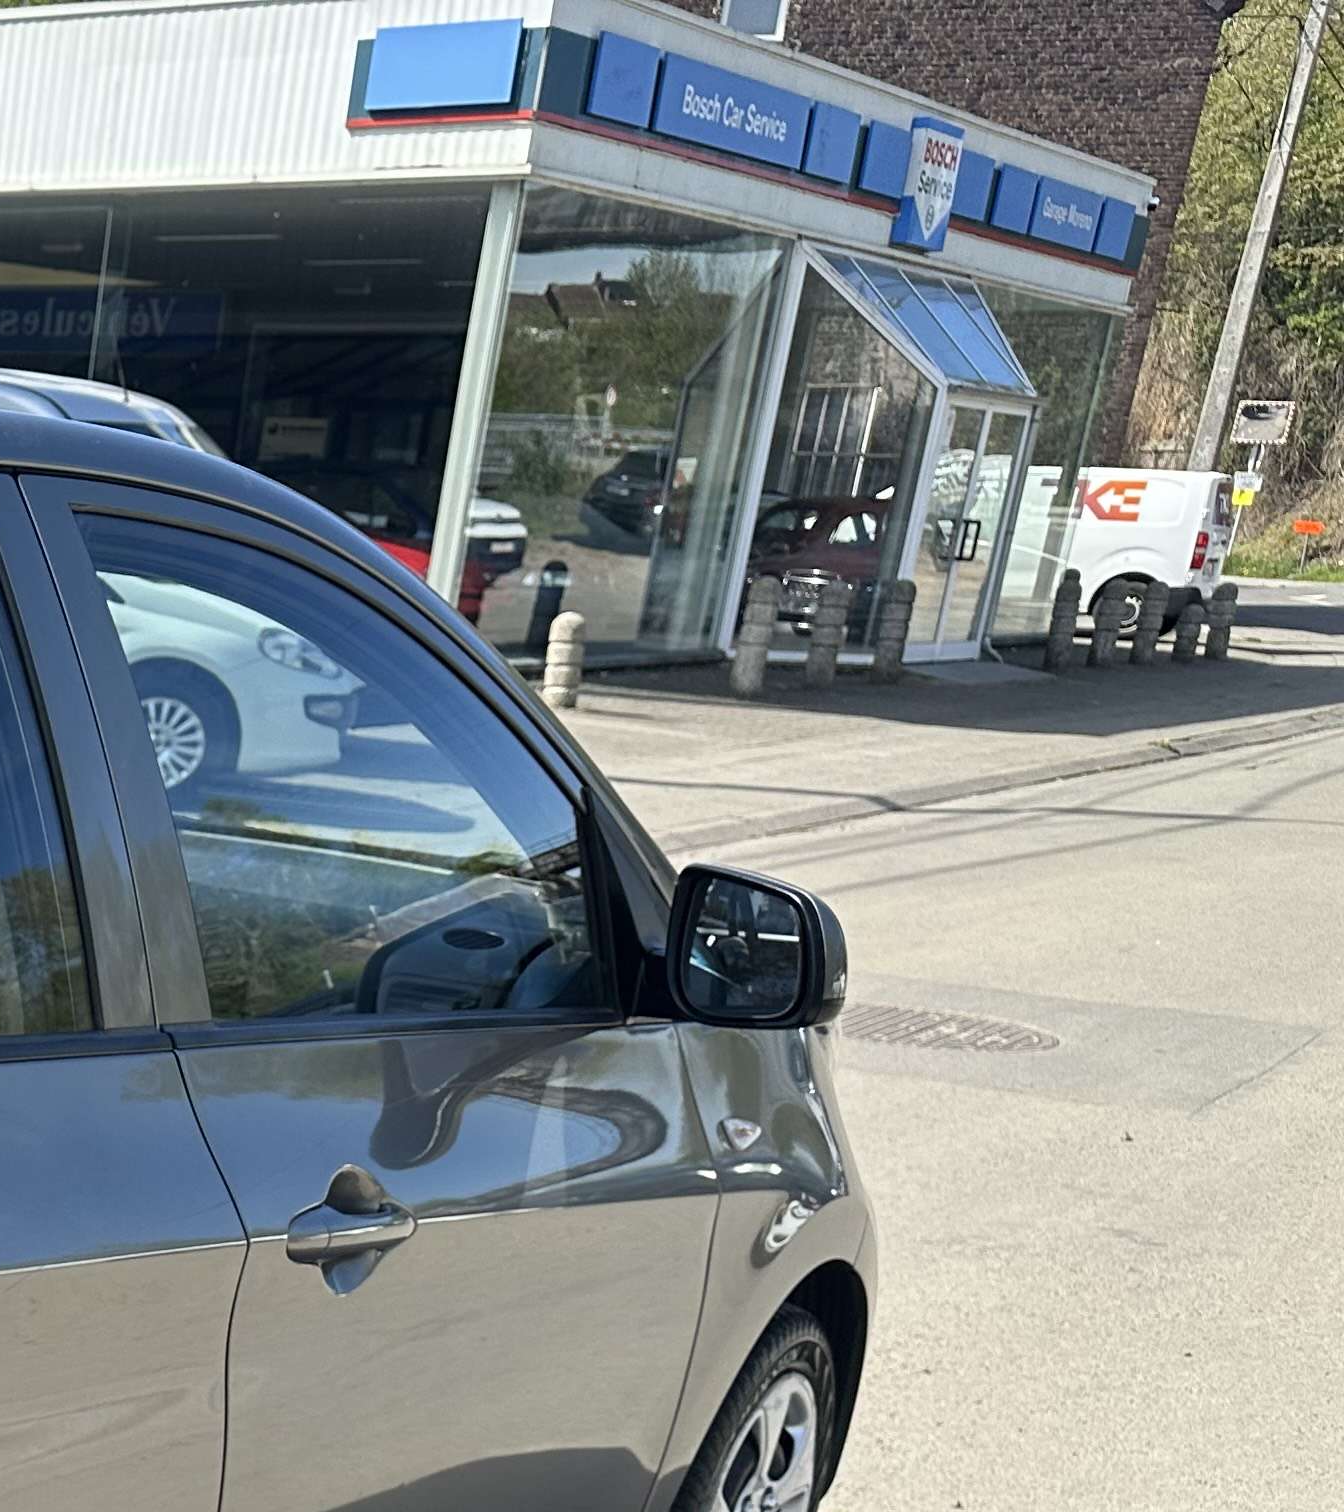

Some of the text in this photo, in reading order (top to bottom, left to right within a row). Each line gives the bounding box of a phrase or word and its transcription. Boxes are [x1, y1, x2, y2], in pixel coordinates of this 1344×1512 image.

[682, 84, 788, 142] Bosch Car Service
[924, 137, 959, 171] BOSCH
